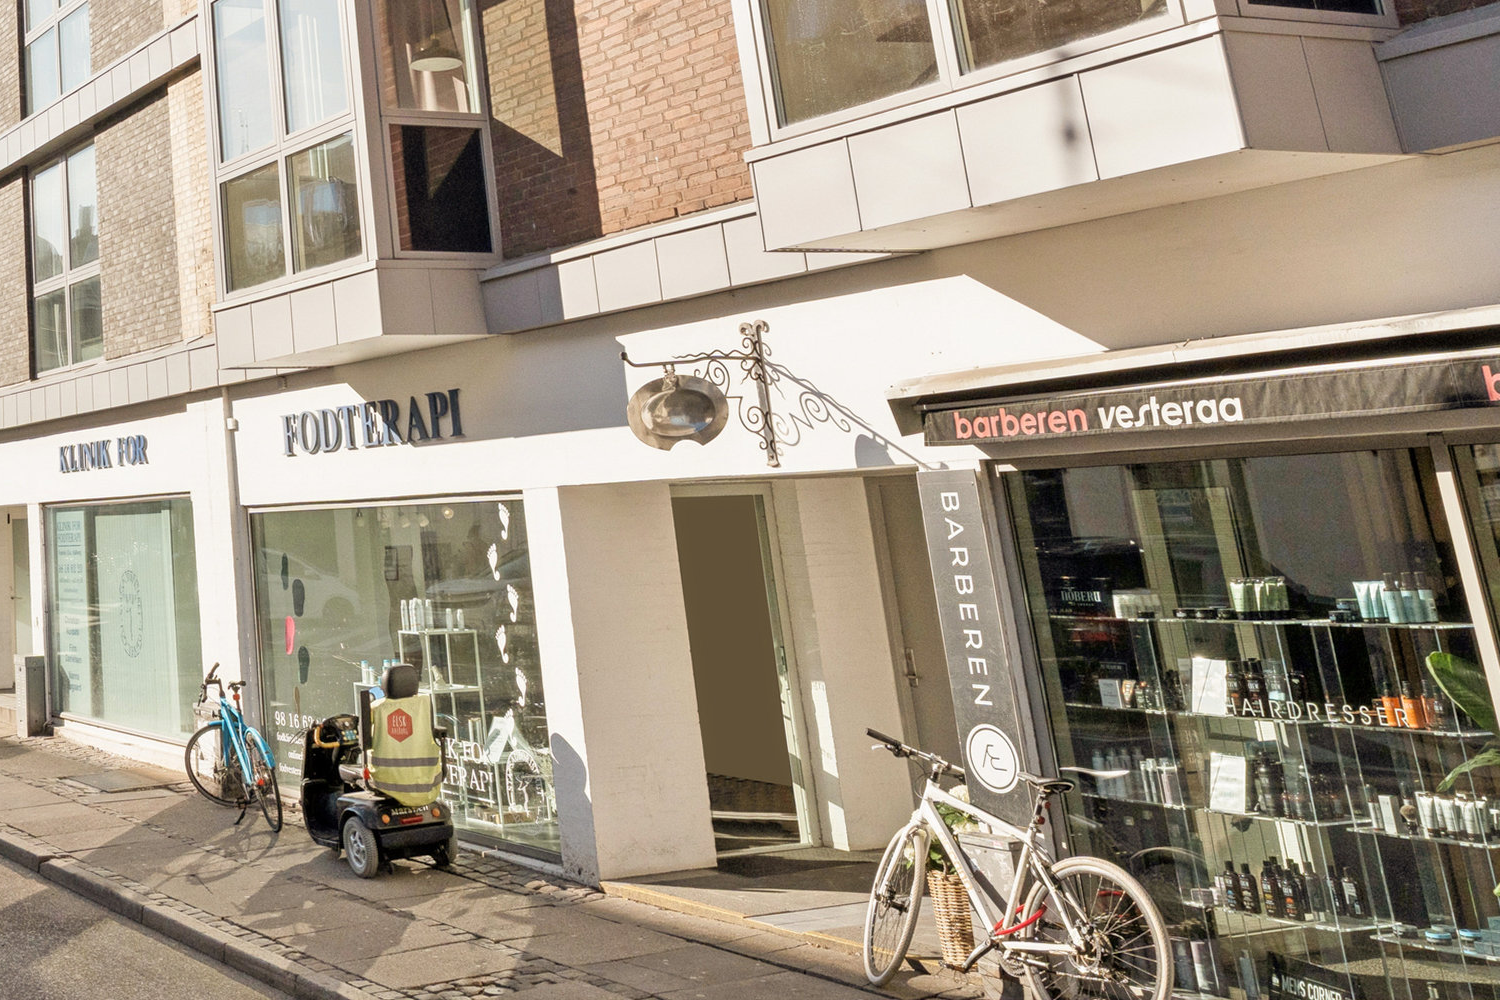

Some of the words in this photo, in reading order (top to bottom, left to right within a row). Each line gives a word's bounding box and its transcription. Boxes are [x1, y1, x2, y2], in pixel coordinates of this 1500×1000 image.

[280, 388, 464, 457] FODTERAPI
[953, 407, 1089, 439] barberen
[1097, 396, 1244, 430] vesteraa
[59, 437, 113, 474] KLINIK
[116, 434, 150, 467] FOR
[940, 491, 993, 706] BARBEREN
[274, 710, 287, 727] 98
[288, 713, 300, 729] 16
[1225, 697, 1410, 728] HAIRDRESSER
